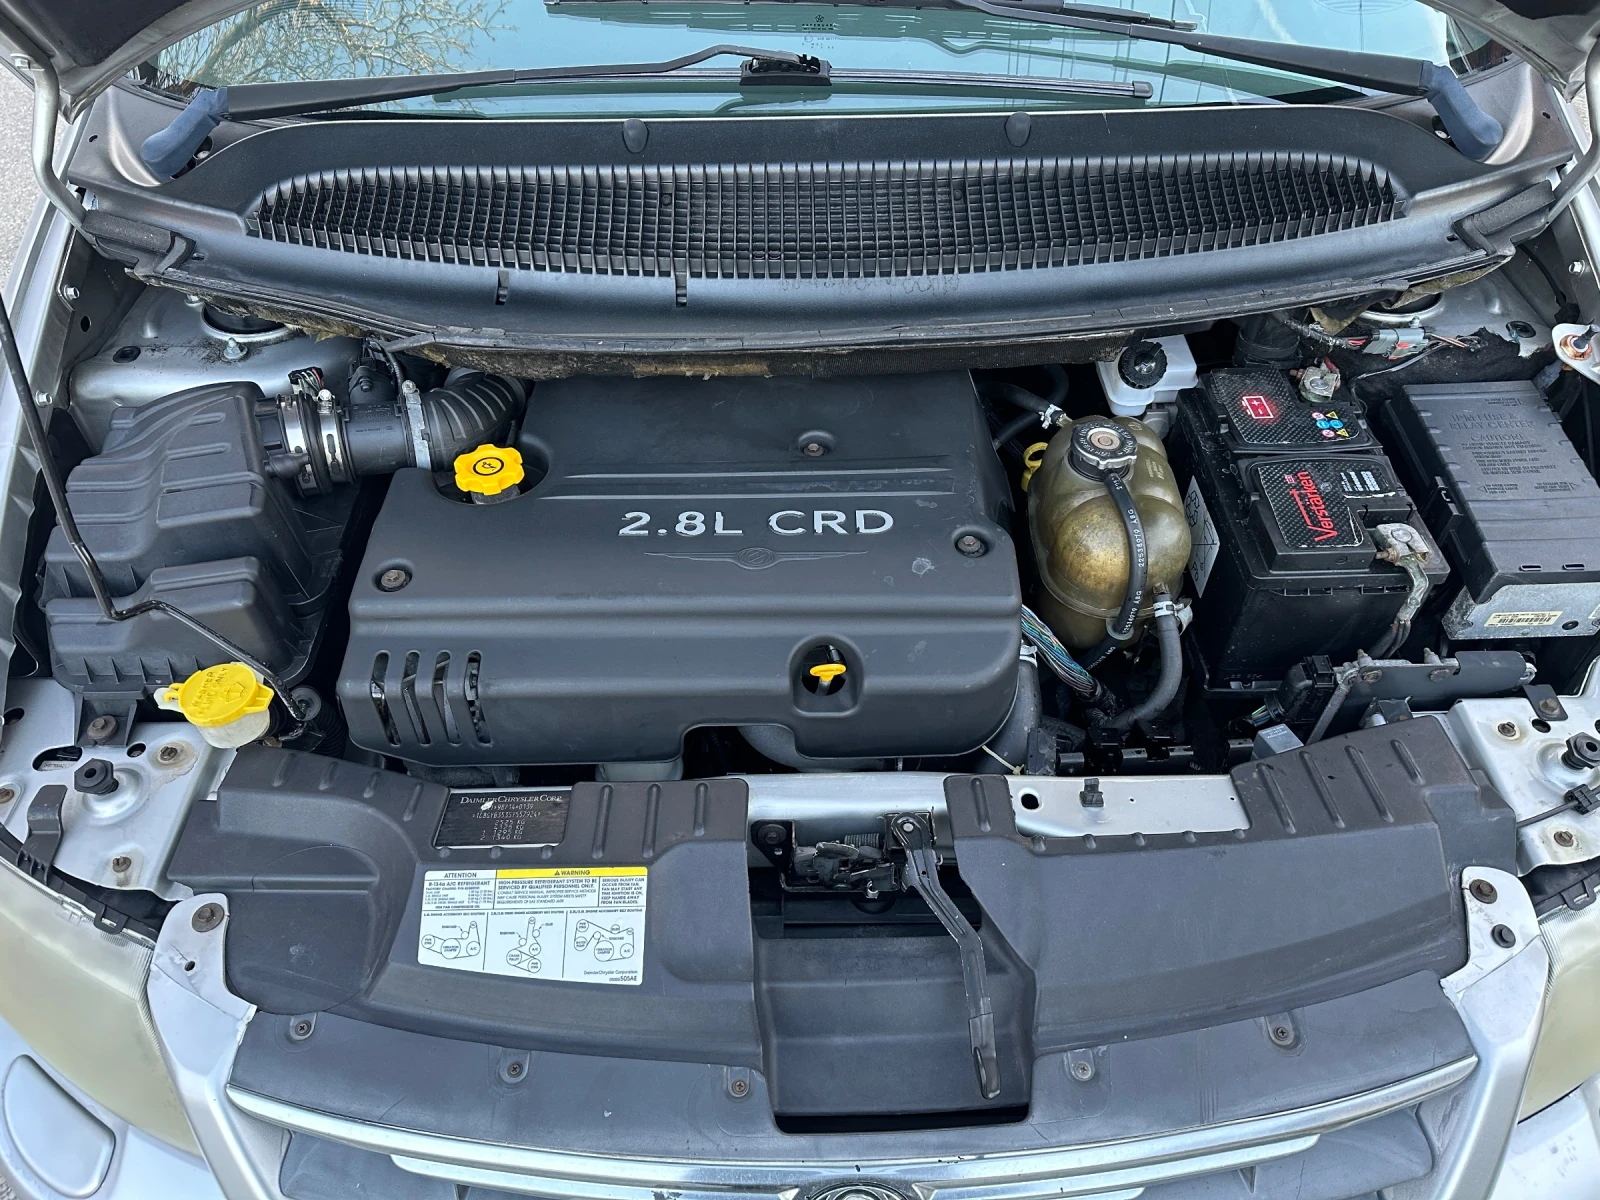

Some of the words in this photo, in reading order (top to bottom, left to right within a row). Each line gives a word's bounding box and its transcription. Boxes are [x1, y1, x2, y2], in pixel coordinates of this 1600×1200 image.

[1127, 508, 1138, 524] ABG
[1290, 470, 1338, 542] Verstärken
[618, 510, 744, 536] 2.8L
[767, 509, 894, 536] CRD
